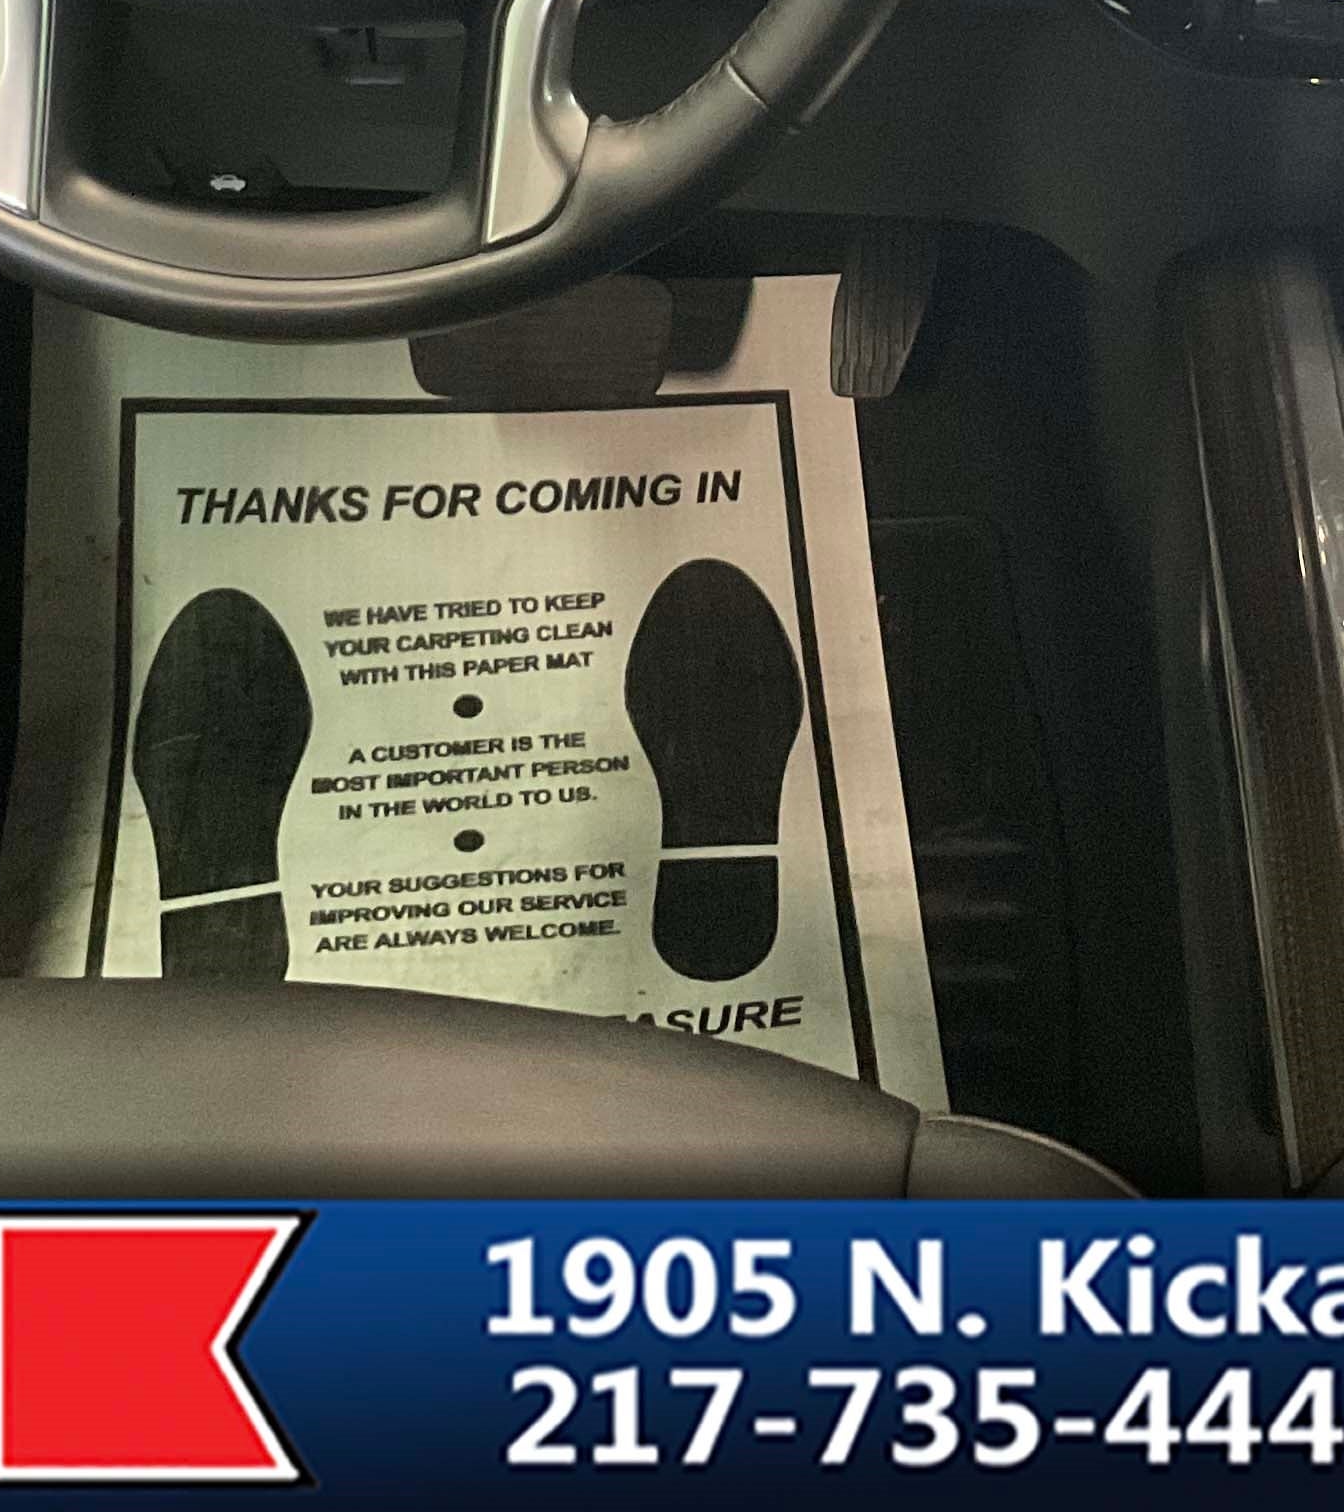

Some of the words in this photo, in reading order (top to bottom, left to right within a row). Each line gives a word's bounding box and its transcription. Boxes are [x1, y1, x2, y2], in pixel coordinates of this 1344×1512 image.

[176, 485, 370, 525] THANKS
[383, 483, 481, 521] FOR
[496, 473, 682, 514] COMING
[696, 470, 743, 504] IN
[323, 607, 361, 628] WE
[367, 604, 428, 626] HAVE
[434, 598, 502, 620] TRIED
[509, 596, 538, 614] TO
[545, 592, 606, 612] KEEP
[323, 636, 390, 658] YOUR
[396, 627, 529, 653] CARPETING
[536, 620, 613, 642] CLEAN
[340, 666, 398, 686] WITH
[404, 662, 456, 682] THIS
[463, 654, 540, 677] PAPER
[546, 651, 594, 669] MAT
[348, 747, 366, 765] A
[371, 738, 505, 763] CUSTOMER
[511, 735, 533, 752] IS
[540, 731, 586, 749] THE
[311, 774, 380, 795] MOST
[386, 763, 525, 789] IMPORTANT
[531, 755, 630, 778] PERSON
[338, 804, 362, 820] IN
[368, 799, 416, 819] THE
[422, 790, 513, 815] WORLD
[519, 788, 552, 807] TO
[558, 786, 598, 803] US.
[311, 879, 382, 900] YOUR
[387, 867, 568, 893] SUGGESTIONS
[574, 861, 626, 882] FOR
[309, 902, 451, 926] IMPROVING
[457, 897, 515, 917] OUR
[520, 889, 628, 912] SERVICE
[315, 934, 369, 953] ARE
[374, 927, 479, 950] ALWAYS
[484, 919, 621, 943] WELCOME.
